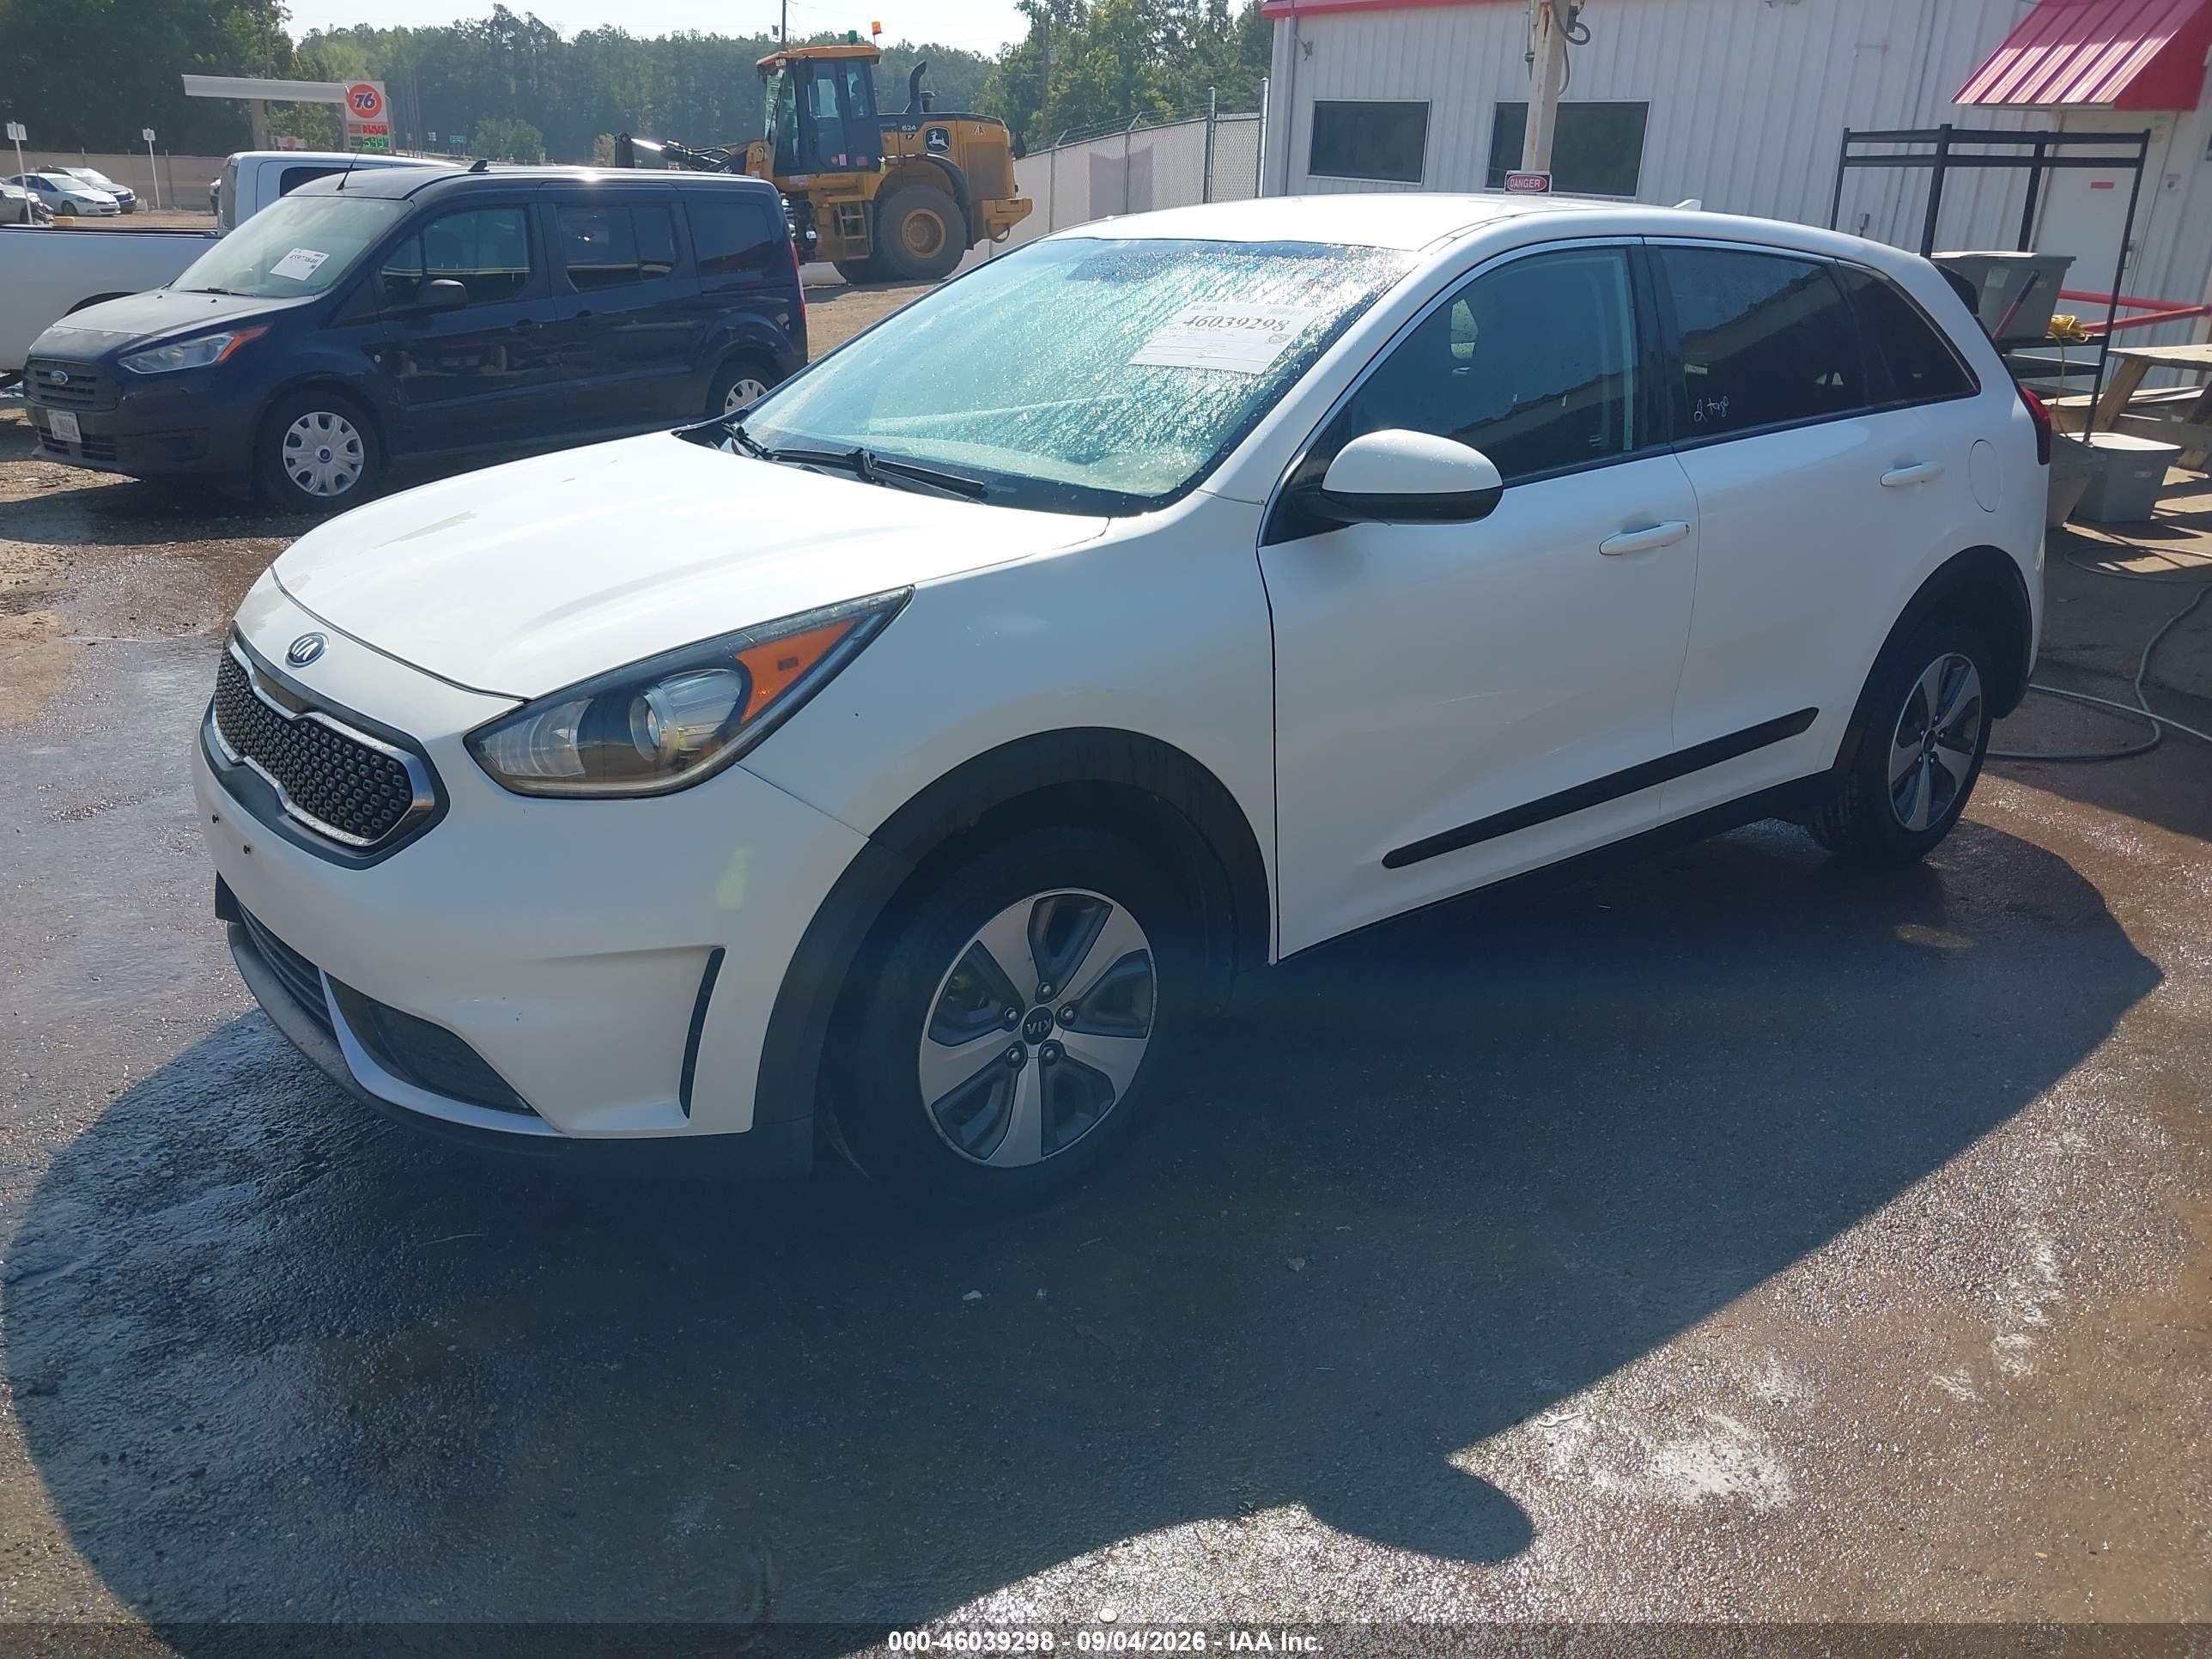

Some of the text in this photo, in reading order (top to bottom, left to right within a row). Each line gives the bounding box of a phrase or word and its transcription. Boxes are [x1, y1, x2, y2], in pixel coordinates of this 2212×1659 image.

[354, 92, 376, 110] 76
[1510, 178, 1540, 188] DANGER
[1182, 315, 1291, 331] 46039298
